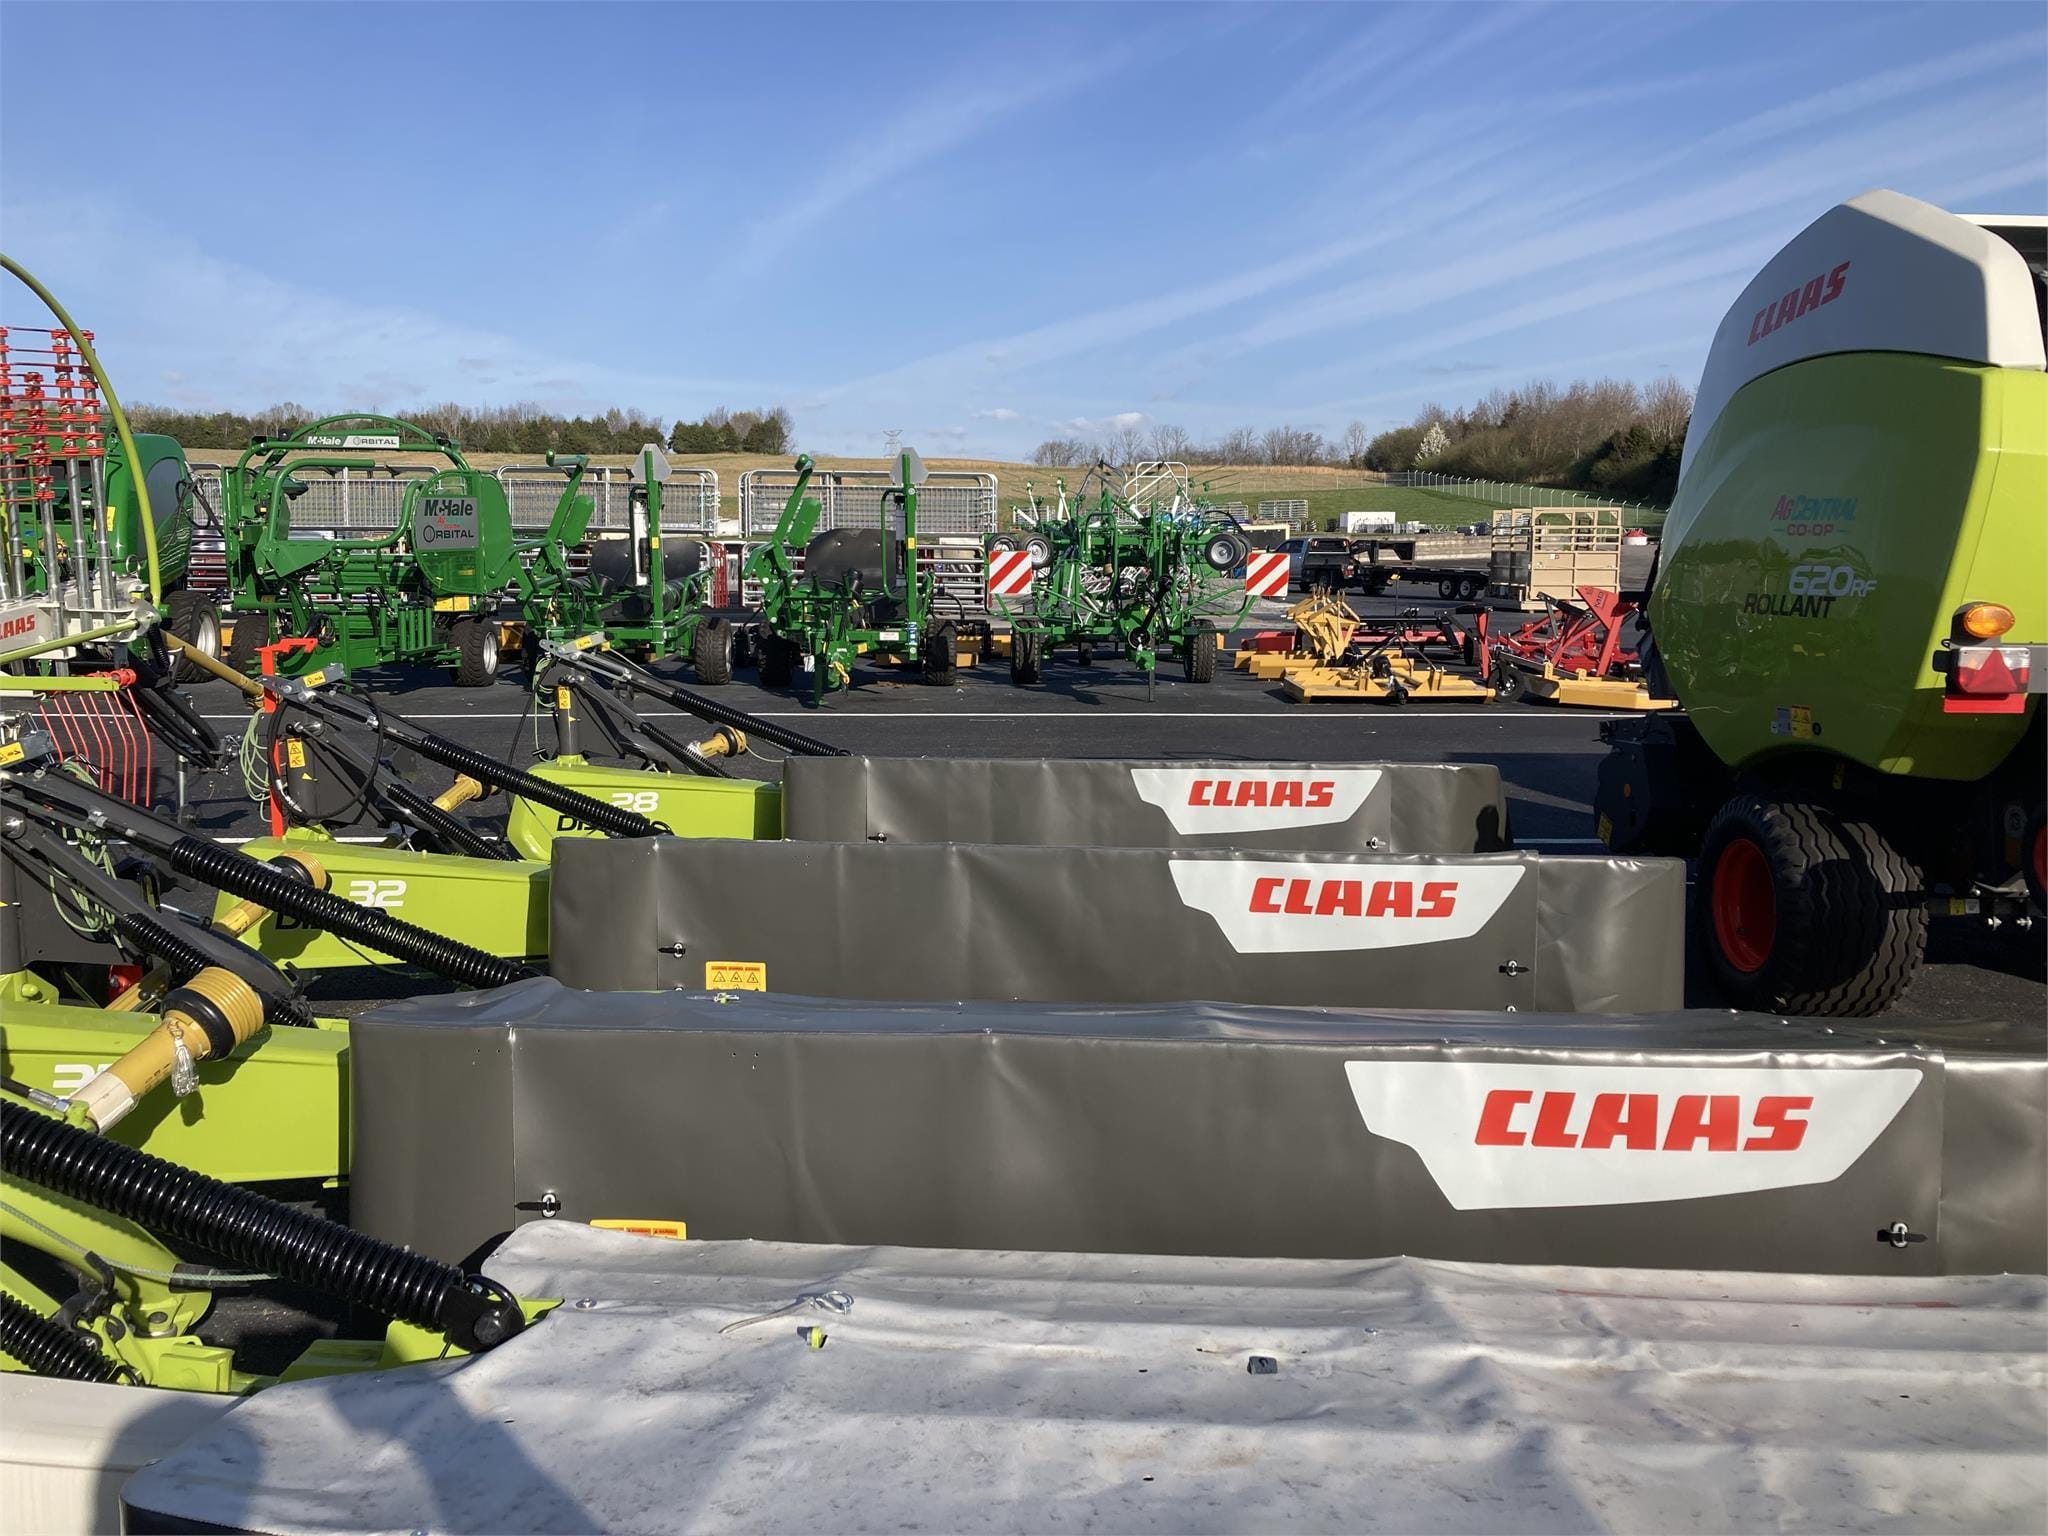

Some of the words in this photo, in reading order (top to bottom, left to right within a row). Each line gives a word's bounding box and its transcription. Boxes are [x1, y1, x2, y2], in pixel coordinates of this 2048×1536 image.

[1747, 260, 1851, 347] CLAAS
[307, 436, 341, 446] McHale
[352, 436, 397, 446] ORBITAL
[424, 499, 473, 517] McHale
[423, 524, 474, 543] ORBITAL
[1786, 523, 1834, 536] CO-OP
[1743, 592, 1836, 619] ROLLANT
[611, 791, 659, 813] 28
[1189, 781, 1334, 806] CLAAS
[349, 879, 407, 907] 32
[1250, 878, 1456, 917] CLAAS
[1475, 1090, 1812, 1151] CLAAS
